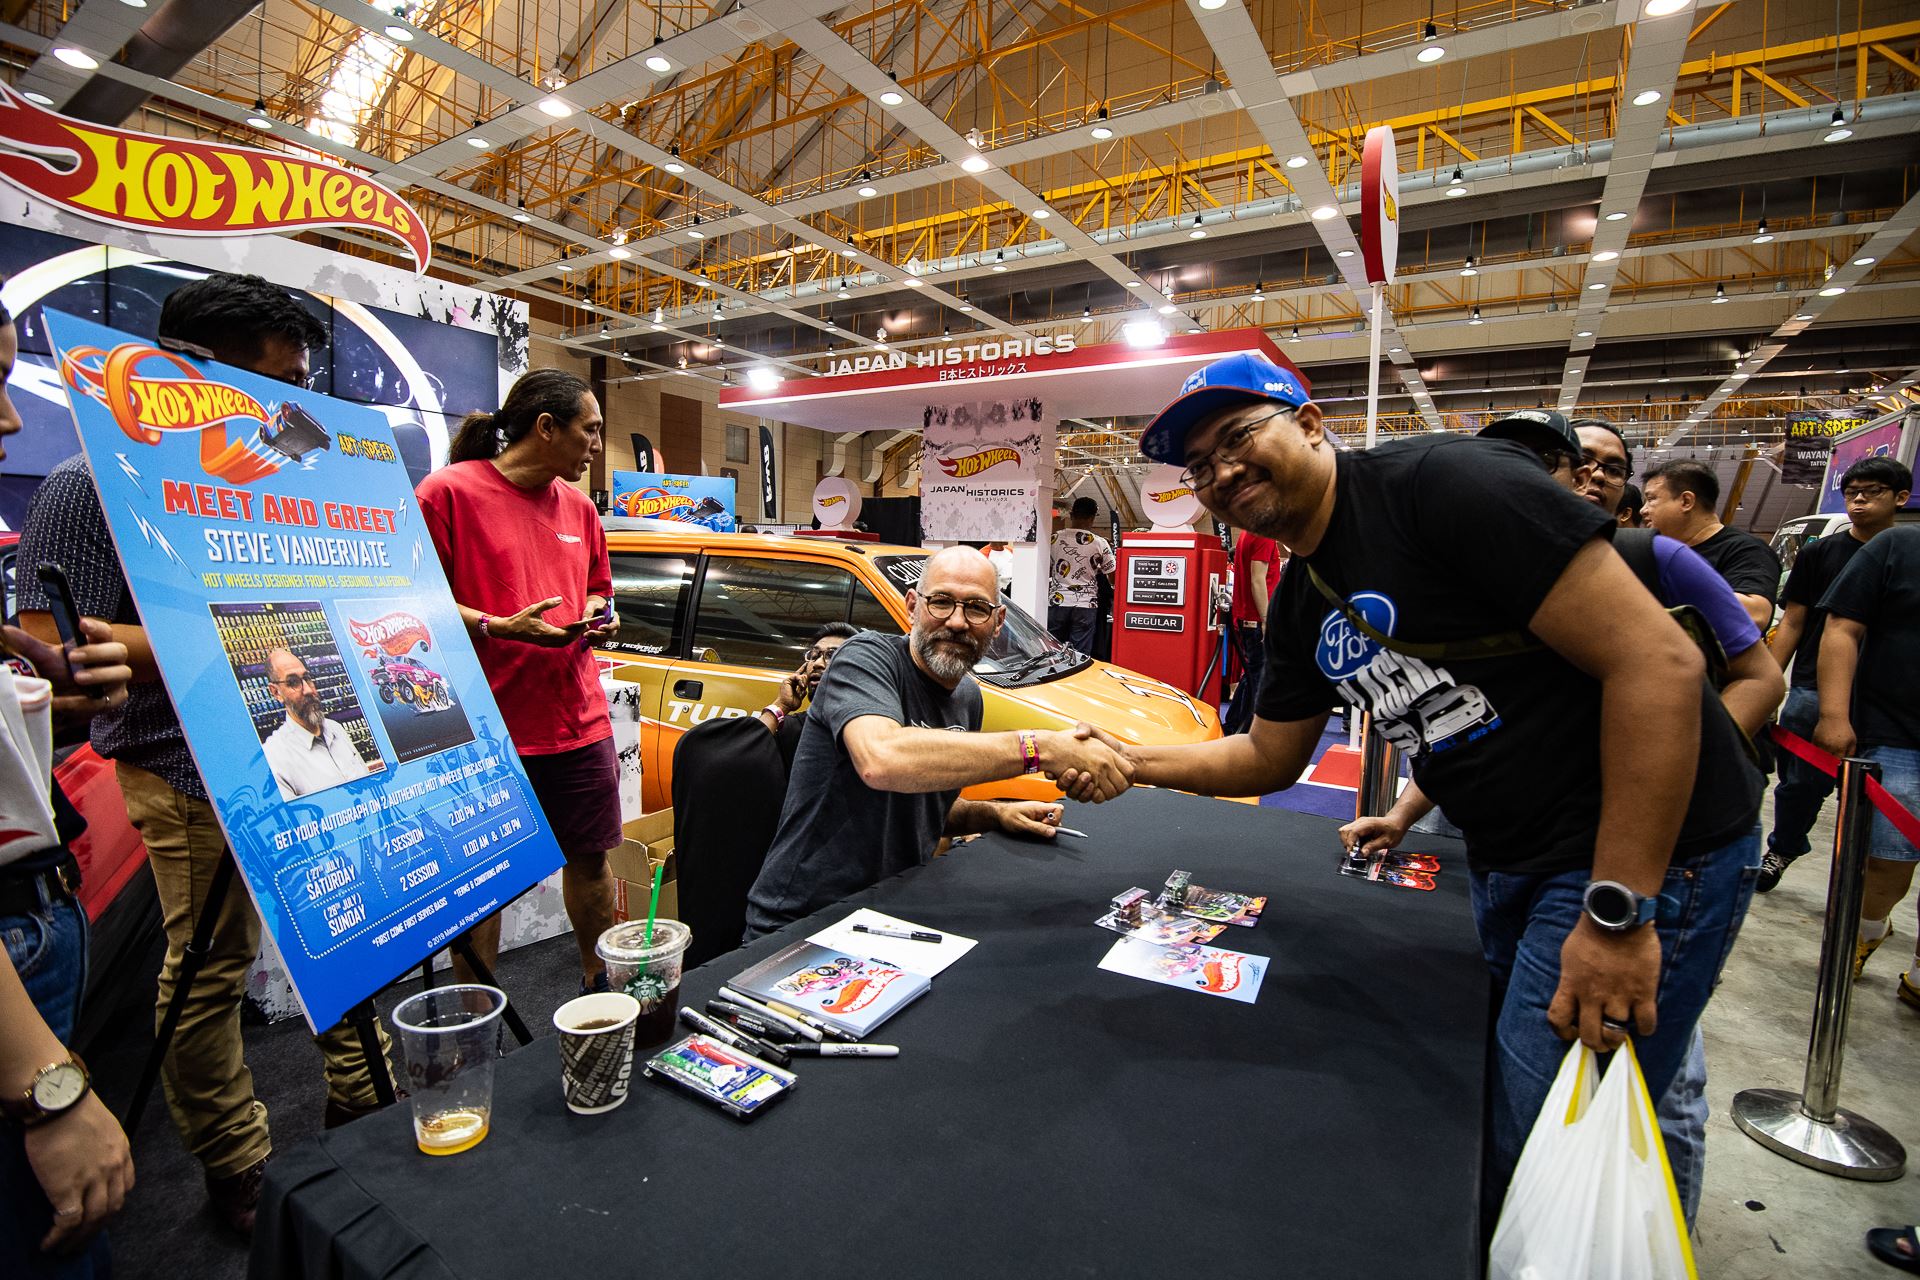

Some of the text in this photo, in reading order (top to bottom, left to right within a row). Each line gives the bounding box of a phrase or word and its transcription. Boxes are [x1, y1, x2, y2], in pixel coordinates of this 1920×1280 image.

[824, 334, 1077, 377] JAPAN HISTORICS
[939, 362, 1027, 382] 日本ヒストリックス
[161, 479, 397, 534] MEET AND GREET
[204, 528, 392, 567] STEVE VANDERVATE
[202, 573, 223, 588] HOT
[224, 574, 263, 588] WHEELS
[264, 575, 304, 588] DESIGNER
[305, 576, 326, 588] FROM
[1131, 617, 1177, 627] REGULAR
[274, 831, 294, 850] GET
[294, 821, 320, 842] YOUR
[320, 803, 370, 833] AUTOGRAPH
[369, 799, 381, 813] ON
[381, 796, 389, 809] 2
[388, 782, 426, 807] AUTHENTIC
[425, 777, 439, 792] HOT
[438, 767, 463, 787] WHEELS
[462, 761, 485, 777] DIECAST
[448, 789, 511, 827] 2.00 PM & 4.00 PM
[384, 827, 426, 856] 2 SESSION
[479, 834, 489, 849] AM
[491, 831, 498, 841] &
[511, 818, 521, 831] PM
[306, 864, 356, 900] SATURDAY
[400, 860, 440, 892] 2 SESSION
[328, 904, 367, 937] SUNDAY
[390, 924, 405, 938] COME
[403, 916, 418, 931] FIRST
[417, 907, 435, 922] SERVES
[432, 932, 445, 945] 2019
[465, 911, 479, 924] Rights
[580, 1034, 621, 1097] CAPPUCCINO
